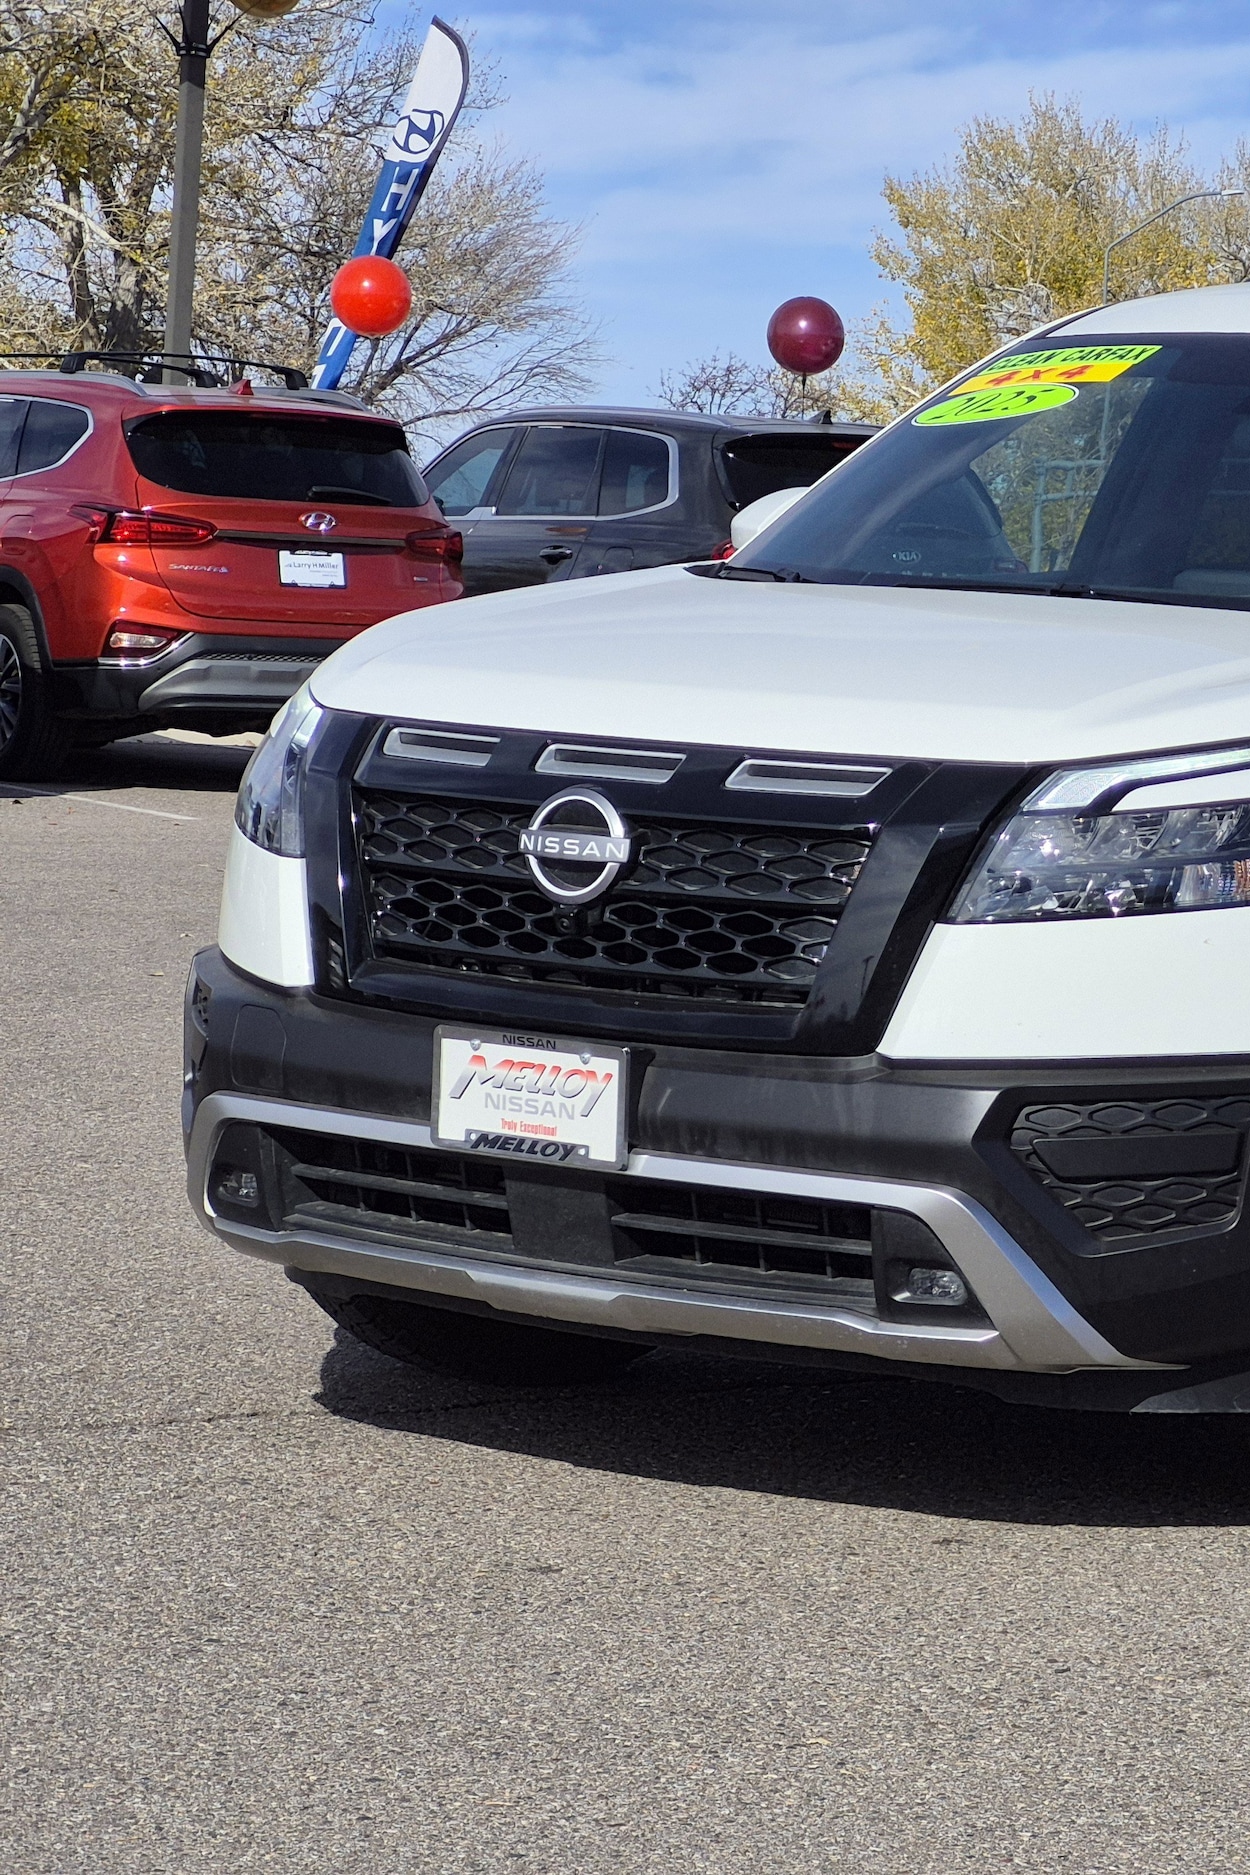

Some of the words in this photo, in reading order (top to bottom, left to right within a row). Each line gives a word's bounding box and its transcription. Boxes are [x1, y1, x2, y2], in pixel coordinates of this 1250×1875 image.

[986, 351, 1065, 371] CLEAN
[1060, 347, 1155, 362] CARFAX
[926, 390, 1056, 422] 2025
[520, 833, 625, 859] NISSAN
[502, 1034, 557, 1050] NISSAN
[449, 1054, 613, 1117] MELLOY
[484, 1092, 576, 1121] NISSAN
[501, 1117, 518, 1133] Truly
[519, 1120, 558, 1137] Exceptional
[470, 1133, 578, 1162] MELLOY
